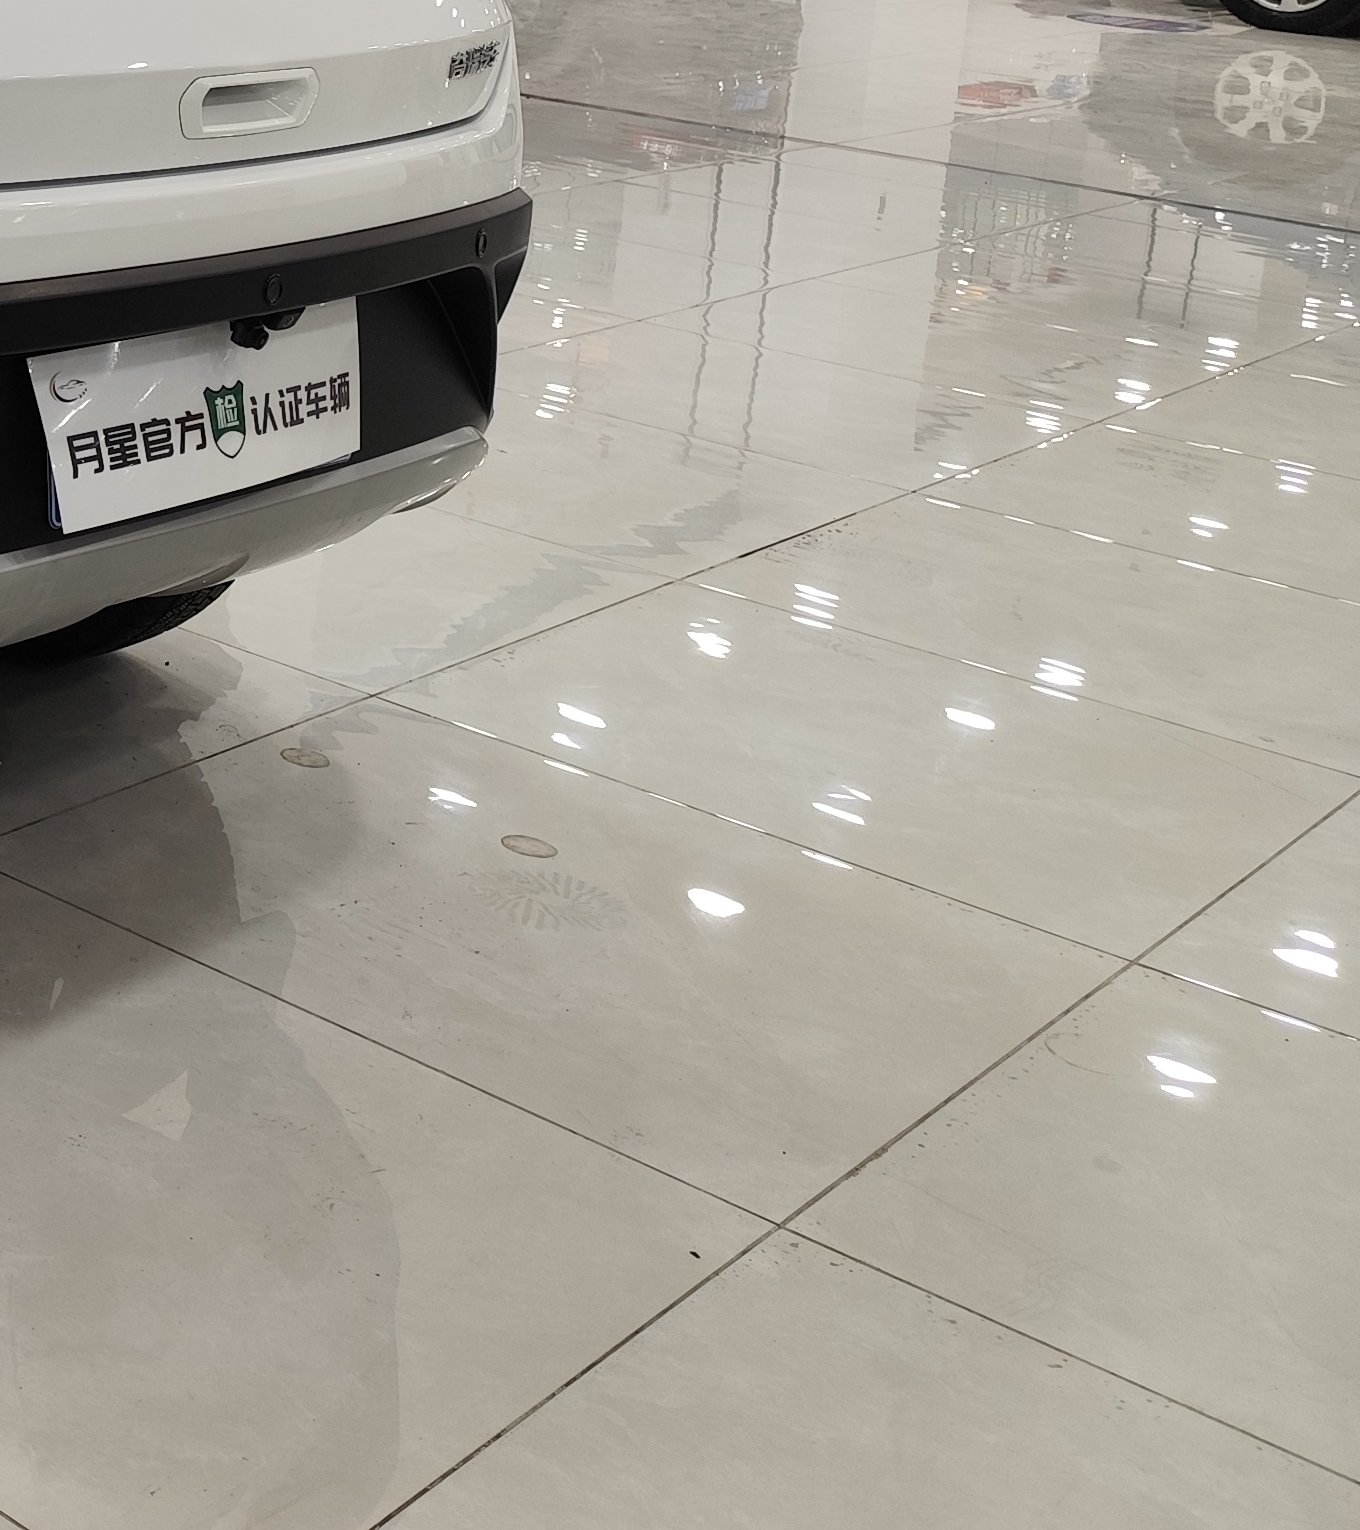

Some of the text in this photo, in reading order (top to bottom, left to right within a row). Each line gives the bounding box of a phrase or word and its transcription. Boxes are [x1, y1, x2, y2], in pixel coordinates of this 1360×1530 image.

[66, 371, 351, 479] 月星官方 检 认证车辆
